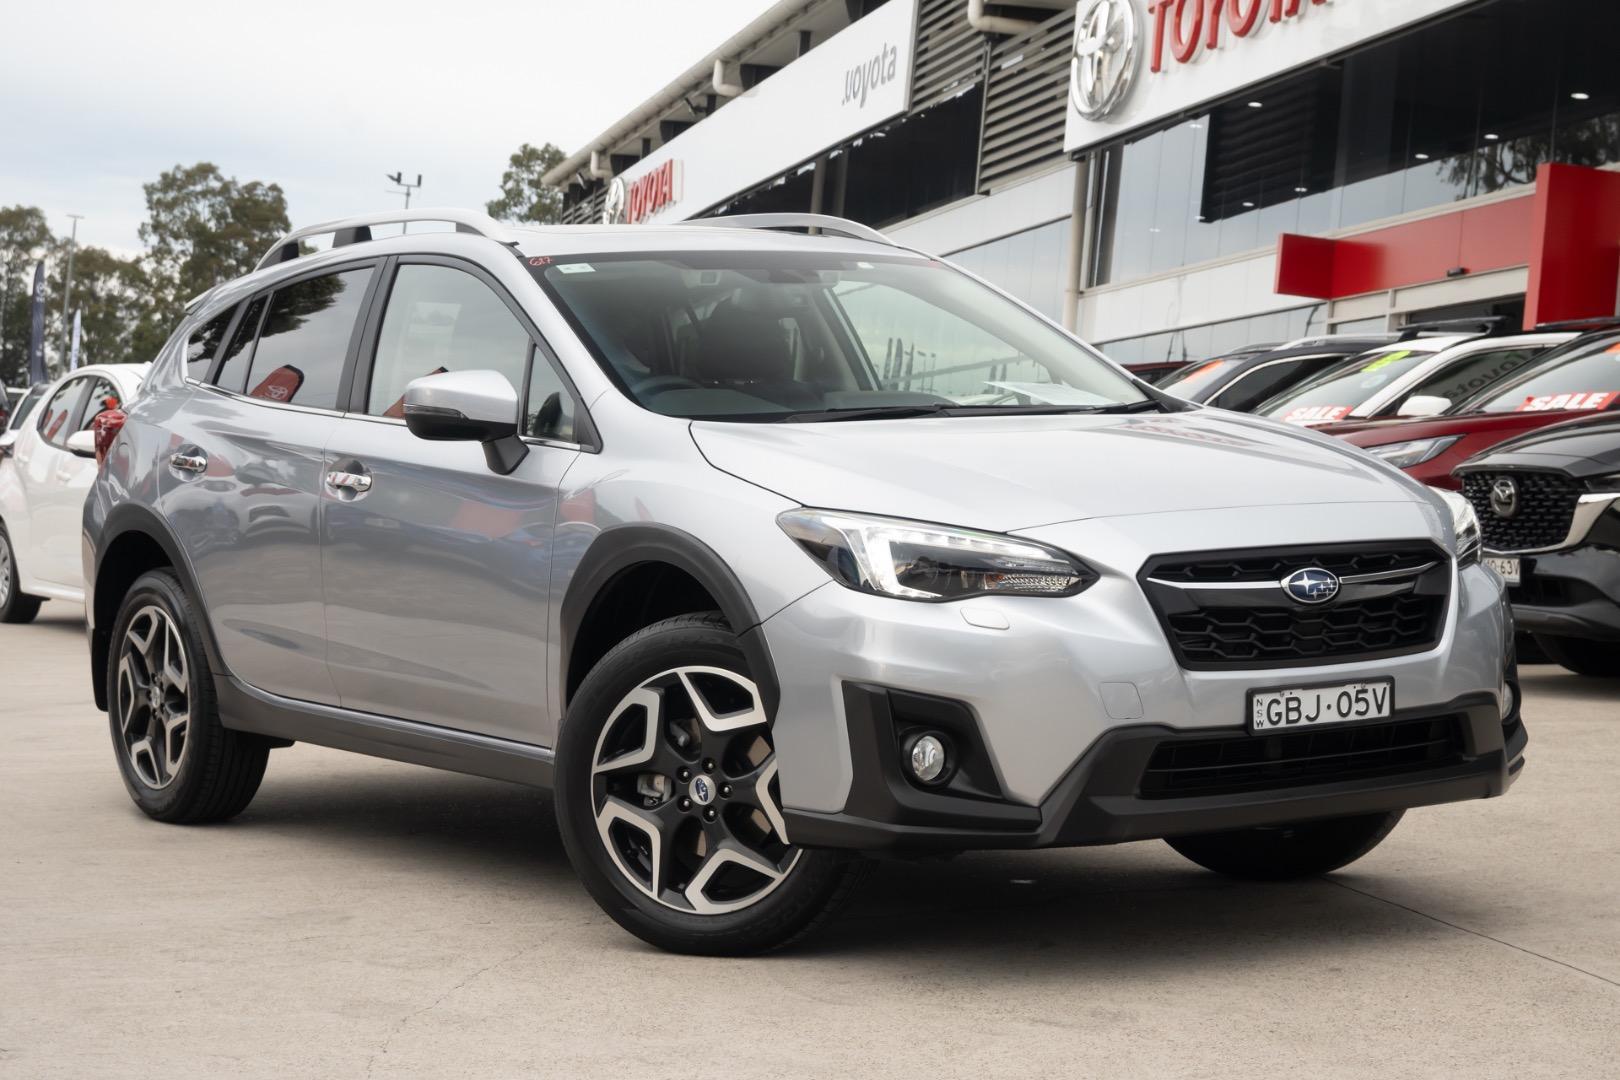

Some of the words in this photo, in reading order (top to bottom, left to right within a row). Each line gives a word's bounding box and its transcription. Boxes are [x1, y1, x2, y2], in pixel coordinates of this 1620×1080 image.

[1149, 0, 1327, 73] TOYO
[626, 159, 673, 224] TOYOTA
[1286, 405, 1347, 420] SALE
[1522, 392, 1610, 411] SALE
